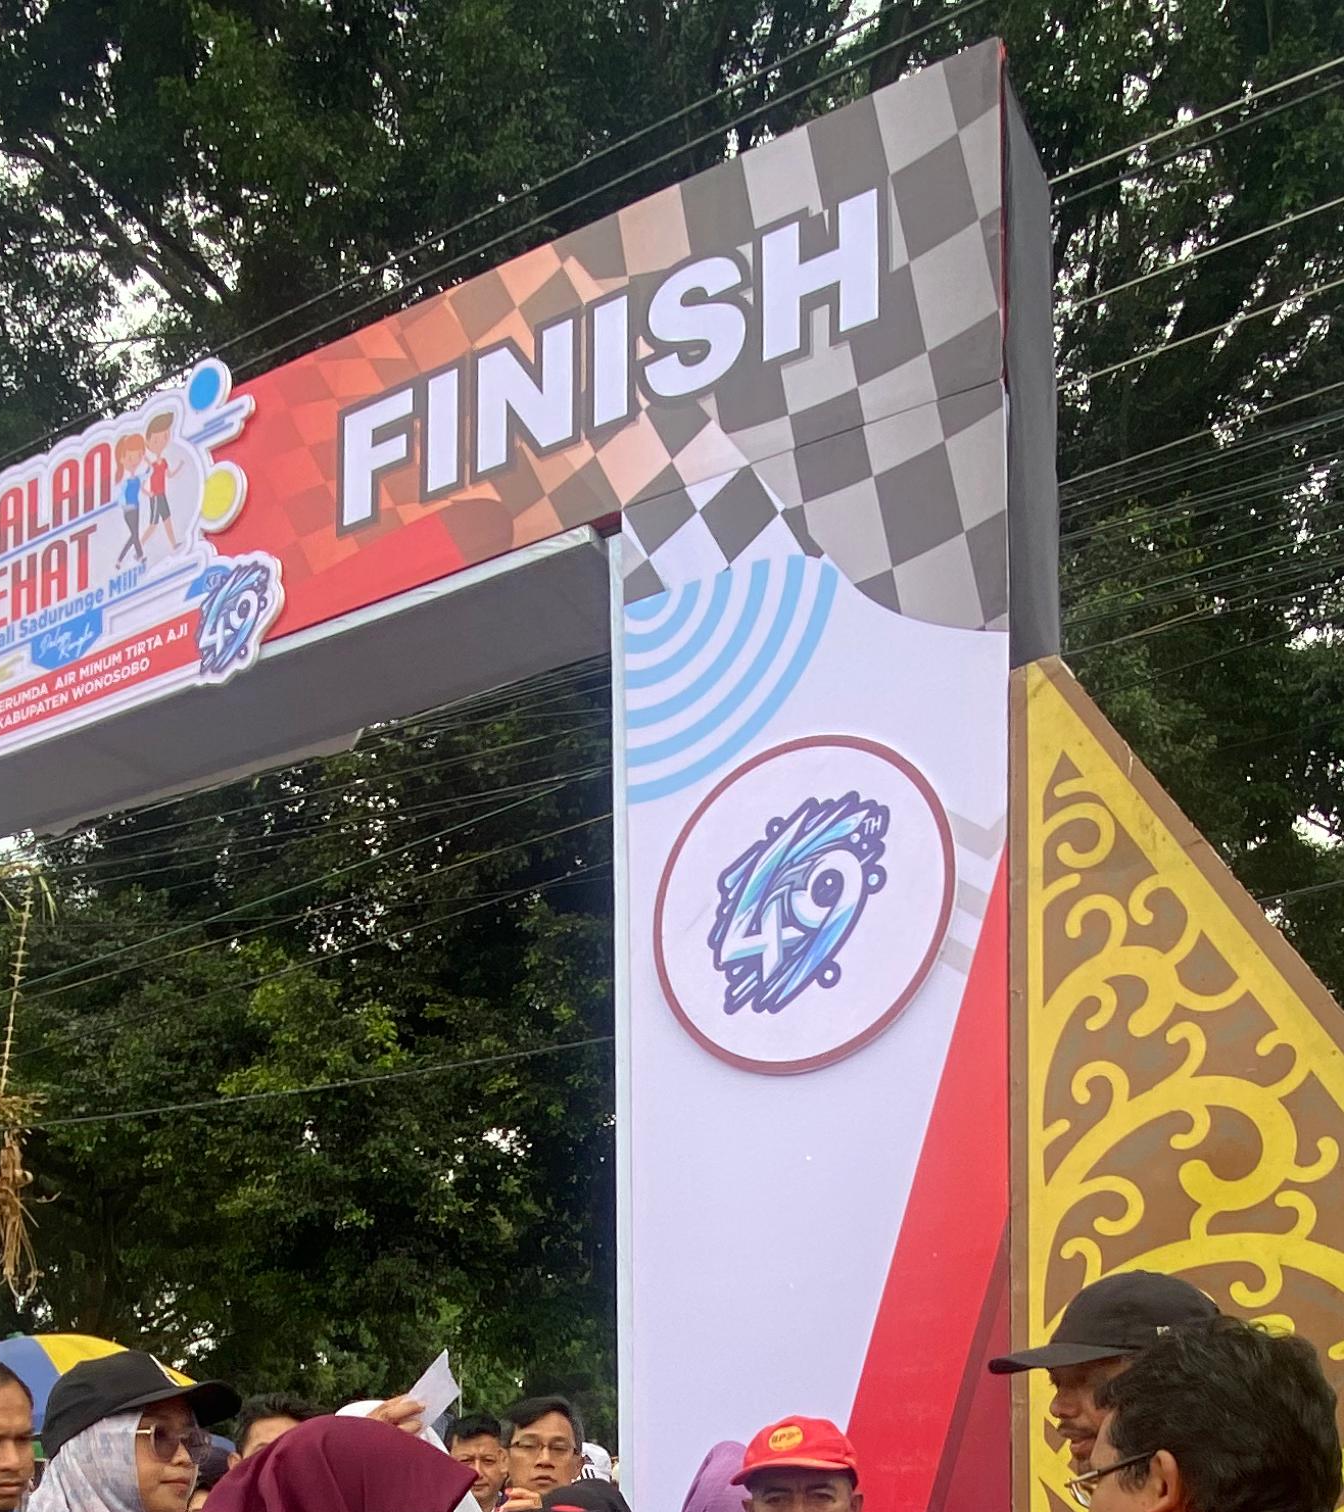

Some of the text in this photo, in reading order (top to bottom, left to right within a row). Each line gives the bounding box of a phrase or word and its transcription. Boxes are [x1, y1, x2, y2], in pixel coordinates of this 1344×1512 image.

[342, 188, 879, 528] FINISH
[20, 587, 104, 638] Sadurunge
[55, 671, 76, 691] AIR
[79, 651, 123, 681] MINUM
[124, 637, 164, 660] TIRTA
[166, 622, 189, 642] AJI
[71, 657, 151, 700] WONOSOBO
